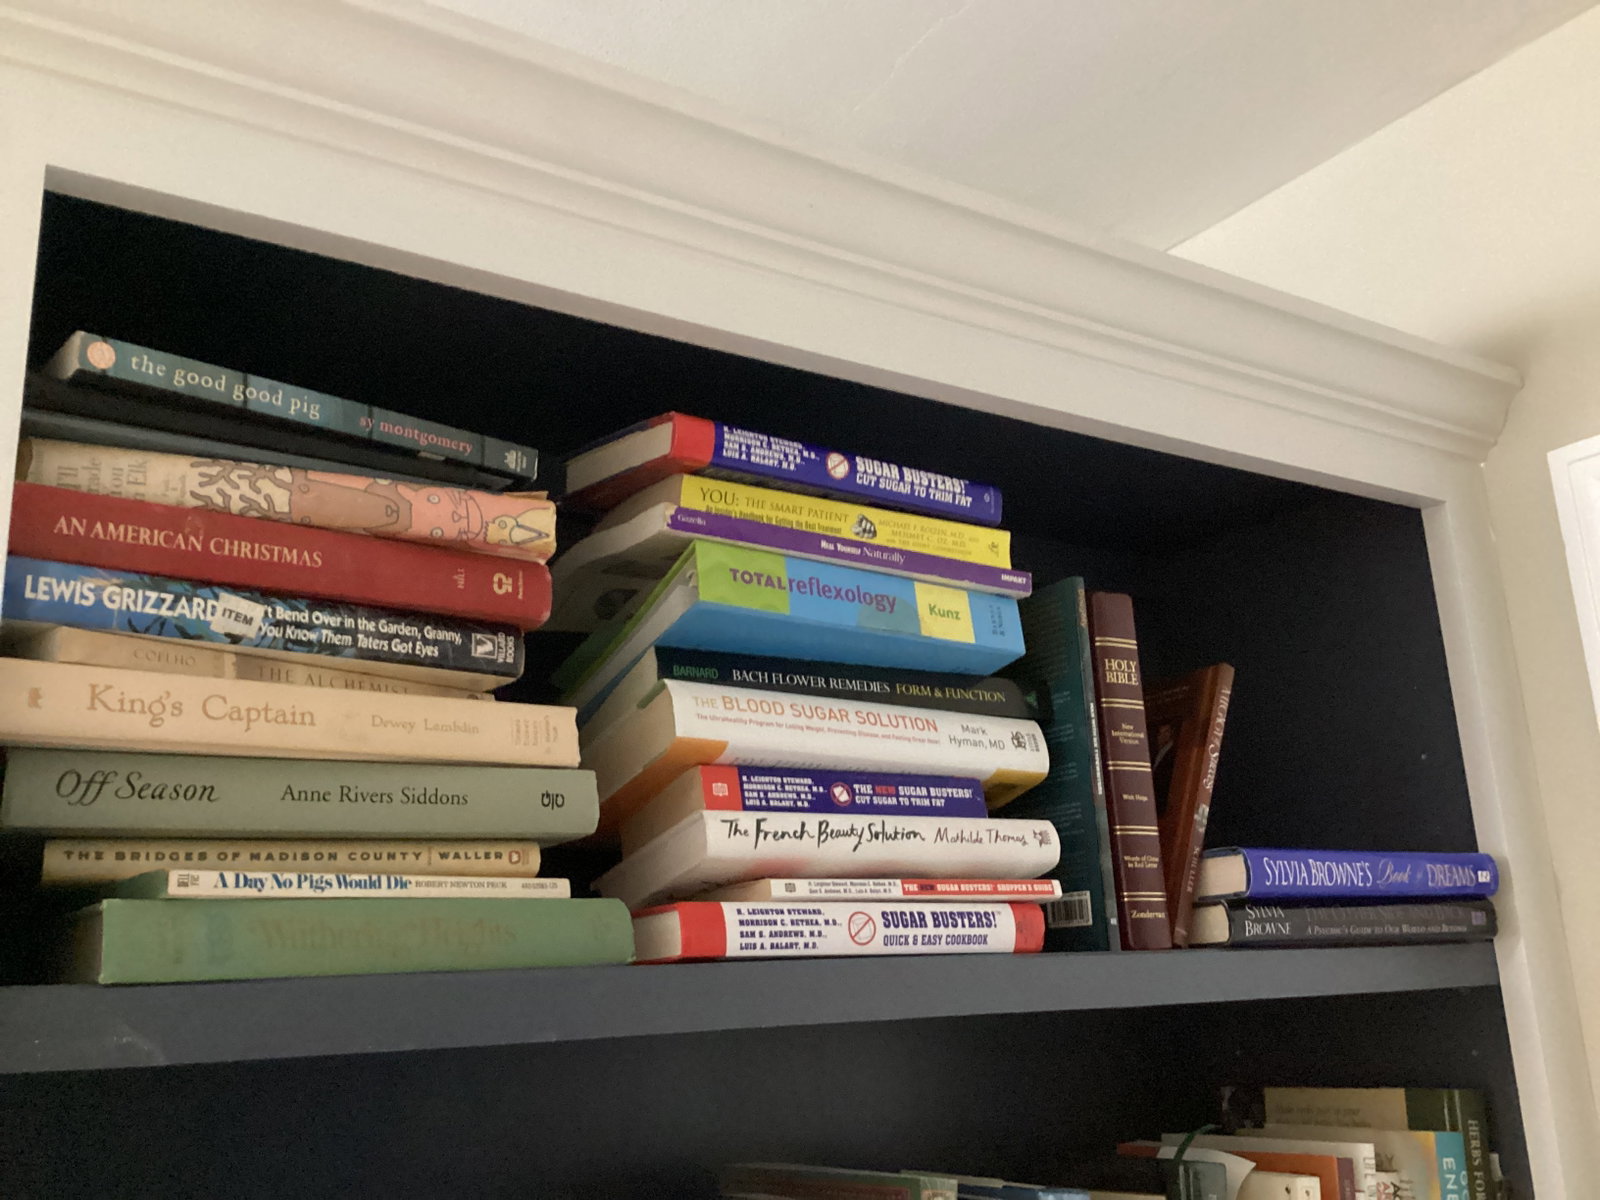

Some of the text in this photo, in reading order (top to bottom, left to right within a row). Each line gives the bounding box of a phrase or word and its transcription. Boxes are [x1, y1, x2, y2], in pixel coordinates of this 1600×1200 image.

[131, 355, 321, 420] the good good pig
[359, 416, 473, 456] sy montgomery
[81, 457, 102, 495] rade
[855, 456, 966, 494] SUGAR BUSTERS!
[856, 472, 877, 488] CUT
[879, 478, 911, 495] SUGAR
[913, 485, 926, 499] TO
[929, 487, 953, 504] TRIM
[955, 494, 973, 508] FAT
[700, 487, 740, 507] YOU:
[744, 496, 766, 511] THE
[769, 500, 804, 517] SMART
[807, 507, 849, 524] PATIENT
[53, 515, 323, 568] AN AMERICAN CHRISTMAS
[863, 547, 906, 565] Naturally
[23, 575, 219, 621] LEWIS GRIZZARD
[729, 568, 897, 614] TOTAL reflexology
[222, 605, 254, 626] ITEM
[928, 603, 961, 620] Kunz
[275, 606, 309, 624] Bend
[312, 610, 341, 628] Over
[344, 615, 355, 629] in
[358, 617, 376, 633] the
[378, 619, 421, 639] Garden,
[424, 626, 462, 645] Granny,
[260, 622, 439, 658] You Know Them Taters Got Eyes
[497, 632, 506, 663] VILLARD
[506, 636, 515, 664] BOOKS
[134, 649, 196, 667] COELHO
[1104, 658, 1137, 673] HOLY
[257, 665, 295, 684] THE
[673, 664, 1006, 703] BARNARD BACH FLOWER REMEDIES FORM & FUNCTION
[1105, 671, 1139, 686] BIBLE
[87, 683, 317, 732] King's Captain
[692, 695, 719, 710] THE
[721, 695, 786, 717] BLOOD
[790, 702, 852, 725] SUGAR
[855, 710, 939, 733] SOLUTION
[371, 714, 416, 735] Dewey
[961, 724, 988, 737] Mark
[949, 735, 988, 752] Hyman,
[989, 738, 1006, 751] MD
[55, 769, 221, 806] Off Season
[280, 784, 469, 806] Anne Rivers Siddons
[852, 784, 873, 795] THE
[898, 785, 928, 797] SUGAR
[929, 786, 973, 799] BUSTERS!
[855, 796, 946, 808] CUT SUGAR TO TRIM FAT
[720, 817, 926, 852] The French Beauty Solution
[933, 826, 984, 845] Mathilde
[62, 850, 504, 862] THE BRIDGES OF MADISON COUNTY WALLER
[213, 871, 229, 890] A
[234, 871, 268, 893] Day
[271, 871, 293, 890] No
[296, 872, 333, 893] Pigs
[333, 873, 382, 891] Would
[385, 874, 413, 891] Die
[1263, 857, 1309, 887] SYLVIA
[1308, 859, 1373, 887] BROWNE'S
[1426, 863, 1477, 888] DREAMS
[415, 880, 508, 890] ROBERT NEWTON PECK
[903, 883, 919, 892] THE
[936, 883, 960, 892] SUGAR
[747, 908, 784, 916] LEIGHTON
[881, 911, 997, 929] SUGAR BUSTERS!
[1244, 904, 1285, 919] SYLVIA
[739, 919, 778, 927] MORRISON
[1244, 920, 1291, 937] BROWNE
[740, 930, 755, 939] SAM
[883, 934, 989, 947] QUICK & EASY COOKBOOK
[740, 942, 757, 951] LUIS
[1467, 1119, 1483, 1167] HERBS
